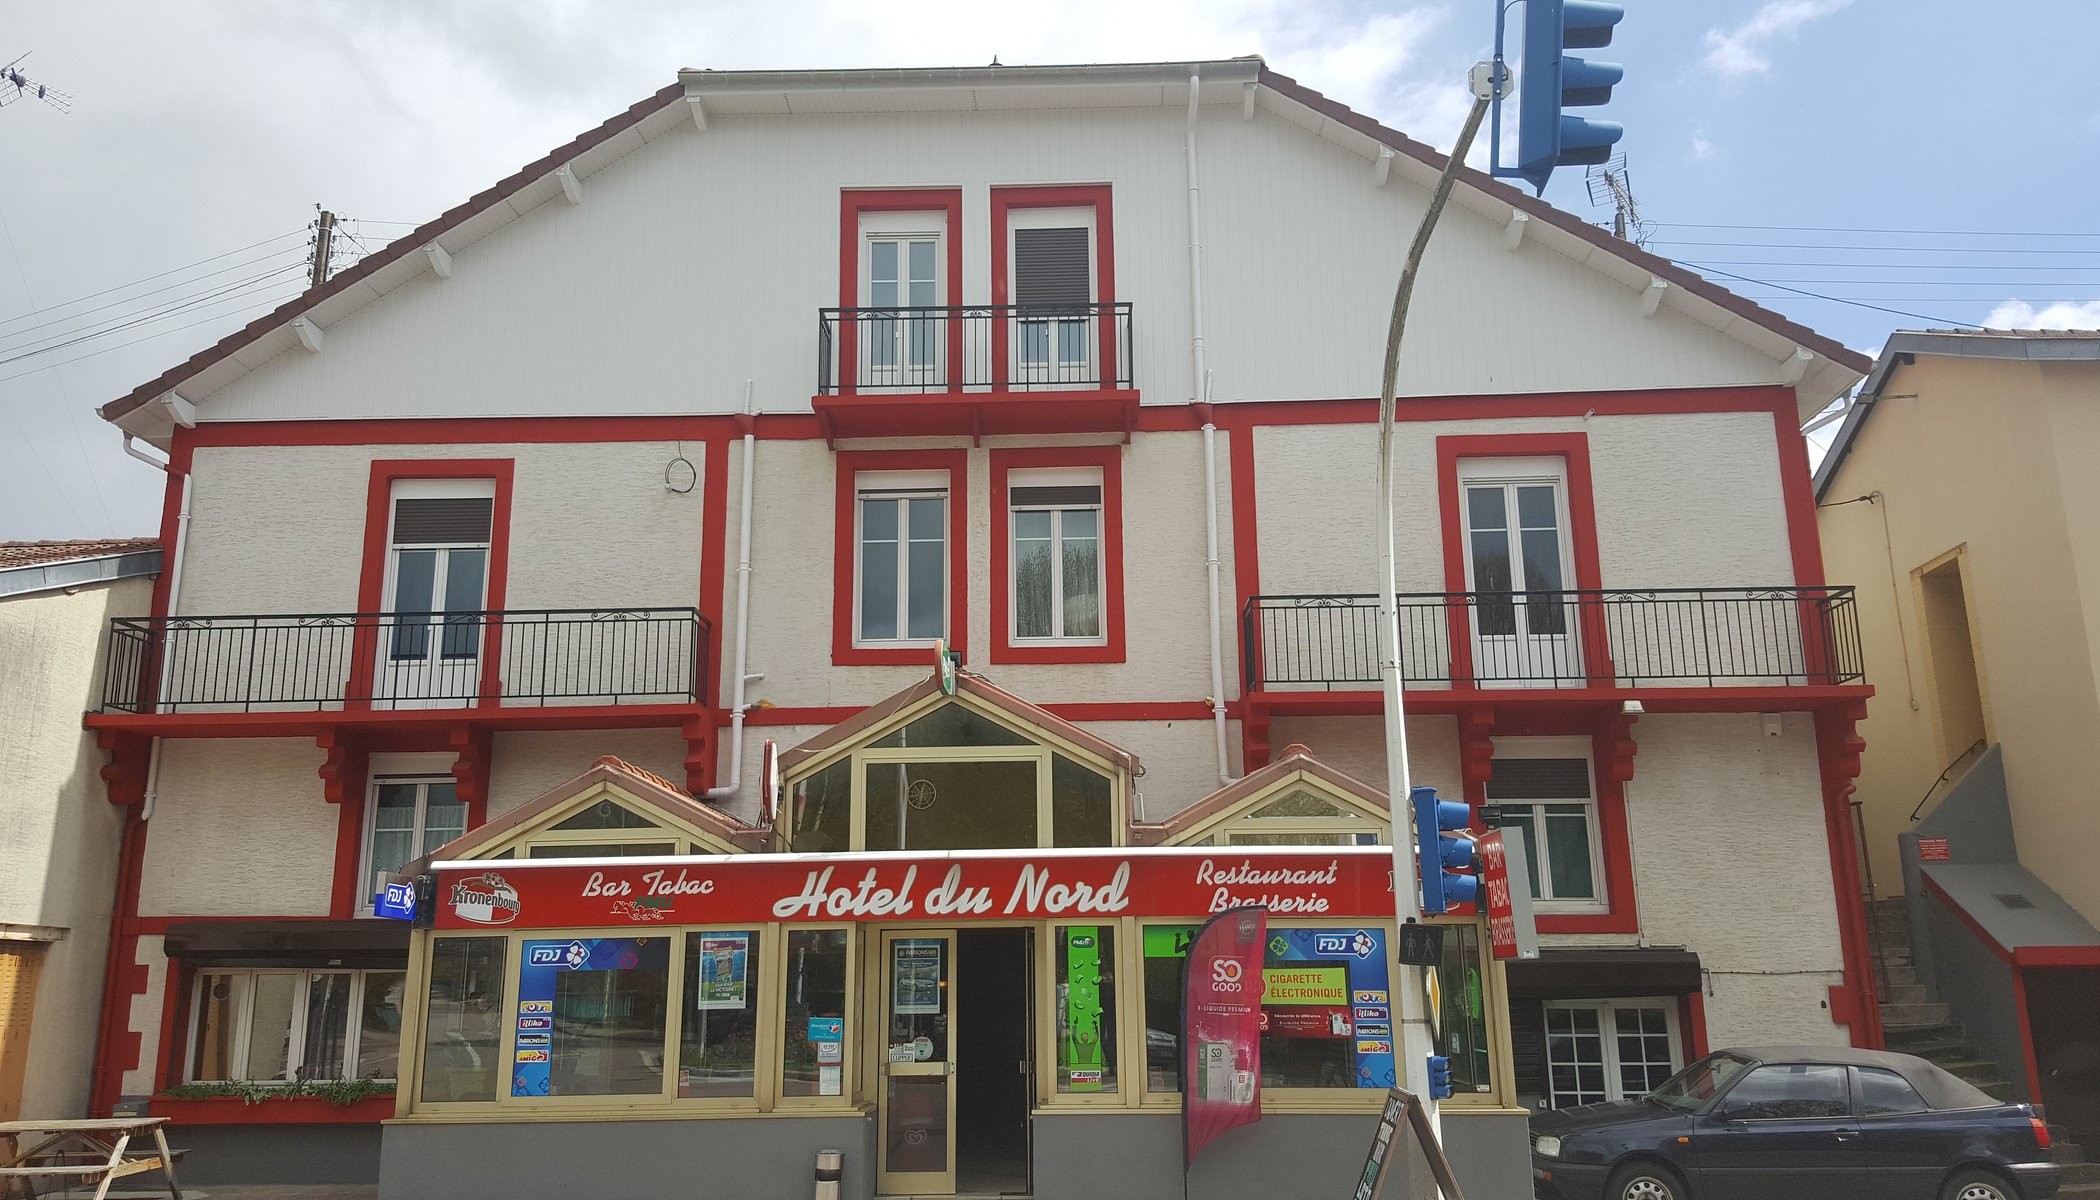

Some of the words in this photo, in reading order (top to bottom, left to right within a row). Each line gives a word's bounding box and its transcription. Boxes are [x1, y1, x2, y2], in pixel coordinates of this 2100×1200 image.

[1486, 843, 1502, 870] BAR
[582, 872, 632, 897] Bar
[643, 868, 714, 896] Tabac
[1196, 859, 1338, 886] Restaurant
[387, 888, 402, 902] FDJ
[449, 885, 521, 914] Kronenbourg
[773, 865, 913, 917] Hotel
[924, 864, 992, 914] du
[1003, 860, 1130, 914] Nord
[1208, 887, 1329, 912] Brasserie
[1319, 939, 1347, 950] FDJ
[533, 950, 561, 962] FDJ
[1213, 960, 1242, 982] SO
[1269, 974, 1322, 984] CIGARETTE
[1212, 982, 1242, 992] GOOD
[1270, 986, 1343, 999] ÉLECTRONIQUE
